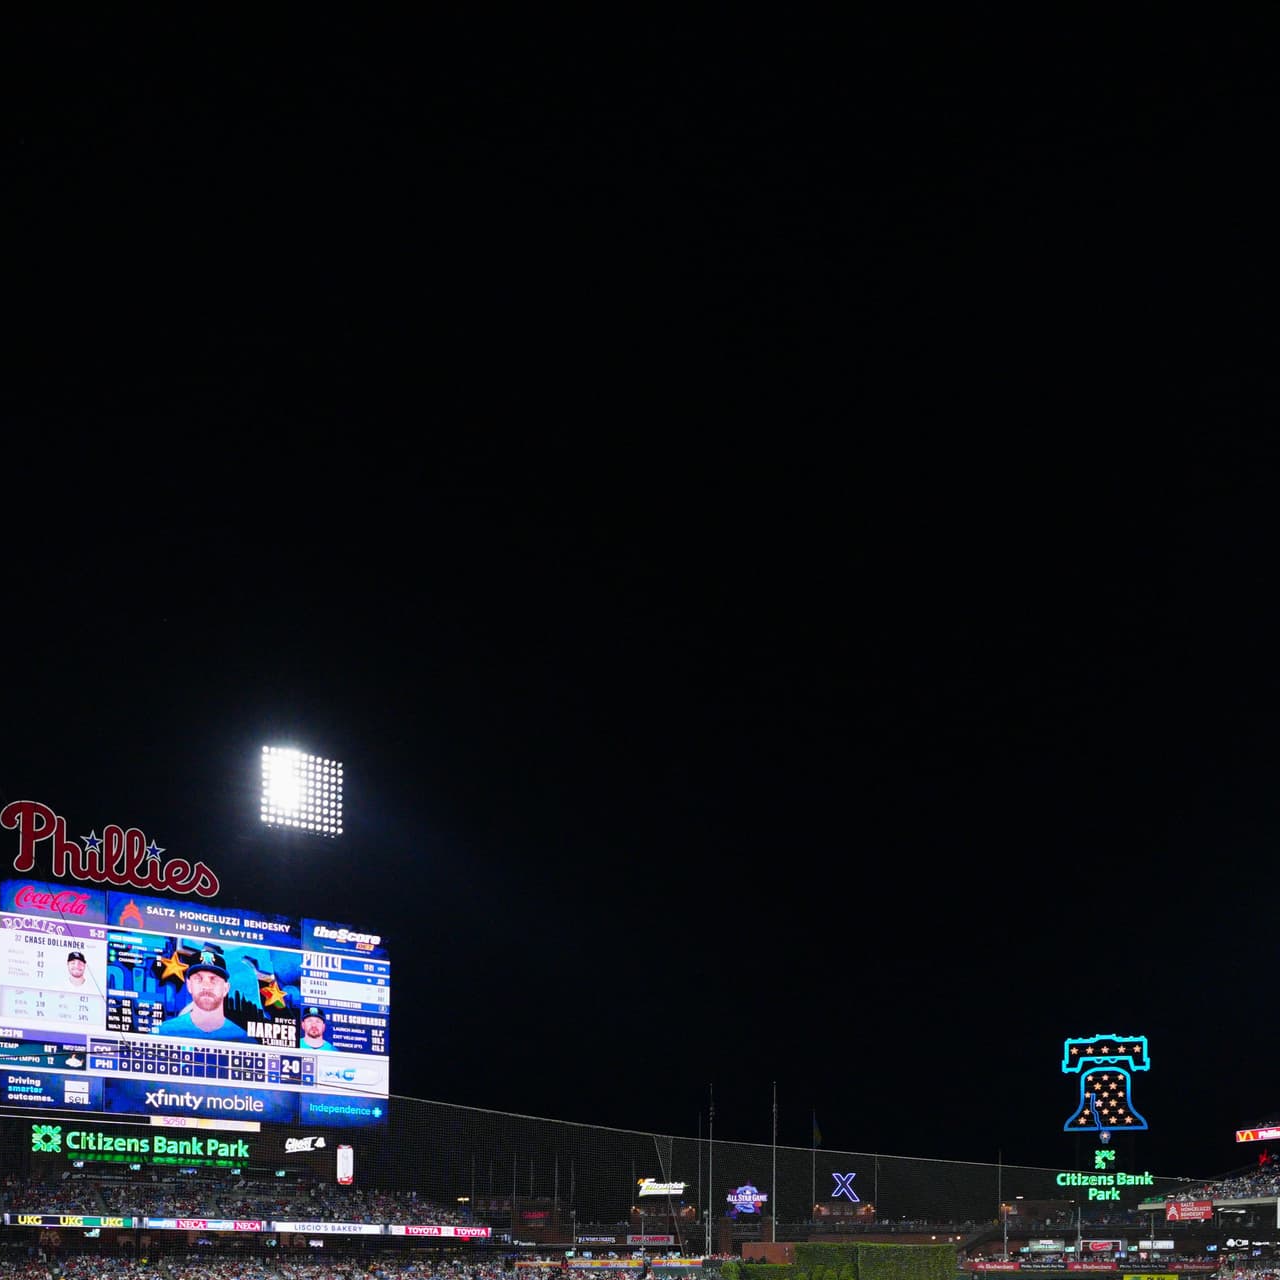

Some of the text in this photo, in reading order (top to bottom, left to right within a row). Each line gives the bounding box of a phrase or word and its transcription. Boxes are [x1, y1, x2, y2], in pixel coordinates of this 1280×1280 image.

[0, 800, 220, 897] Phillies
[14, 885, 91, 915] Coca-Cola
[2, 917, 65, 935] ROCKIES
[146, 906, 291, 933] SALTZ MONGELUZZI BENDESKY
[175, 922, 264, 941] INJURY LAWYERS
[313, 926, 381, 945] theScore
[24, 935, 85, 949] CHASE DOLLANDER
[247, 1021, 297, 1040] HARPER
[95, 1059, 113, 1069] PHI
[282, 1059, 300, 1074] 2-0
[8, 1075, 41, 1087] Driving
[8, 1085, 43, 1094] smarter
[7, 1093, 55, 1103] outcomes.
[145, 1088, 264, 1112] xfinity mobile
[309, 1103, 371, 1117] Independence
[66, 1131, 250, 1158] Citizens Bank Park
[1056, 1171, 1153, 1186] Citizens Bank
[831, 1172, 860, 1202] X
[1088, 1187, 1120, 1201] Park
[18, 1215, 42, 1225] UKG
[59, 1216, 83, 1226] UKG
[100, 1217, 123, 1227] UKG
[178, 1220, 206, 1229] NECA
[234, 1221, 261, 1231] NECA
[294, 1224, 363, 1233] LISCIO'S BAKERY
[408, 1227, 439, 1235] TOYOTA
[456, 1228, 486, 1236] TOYOTA
